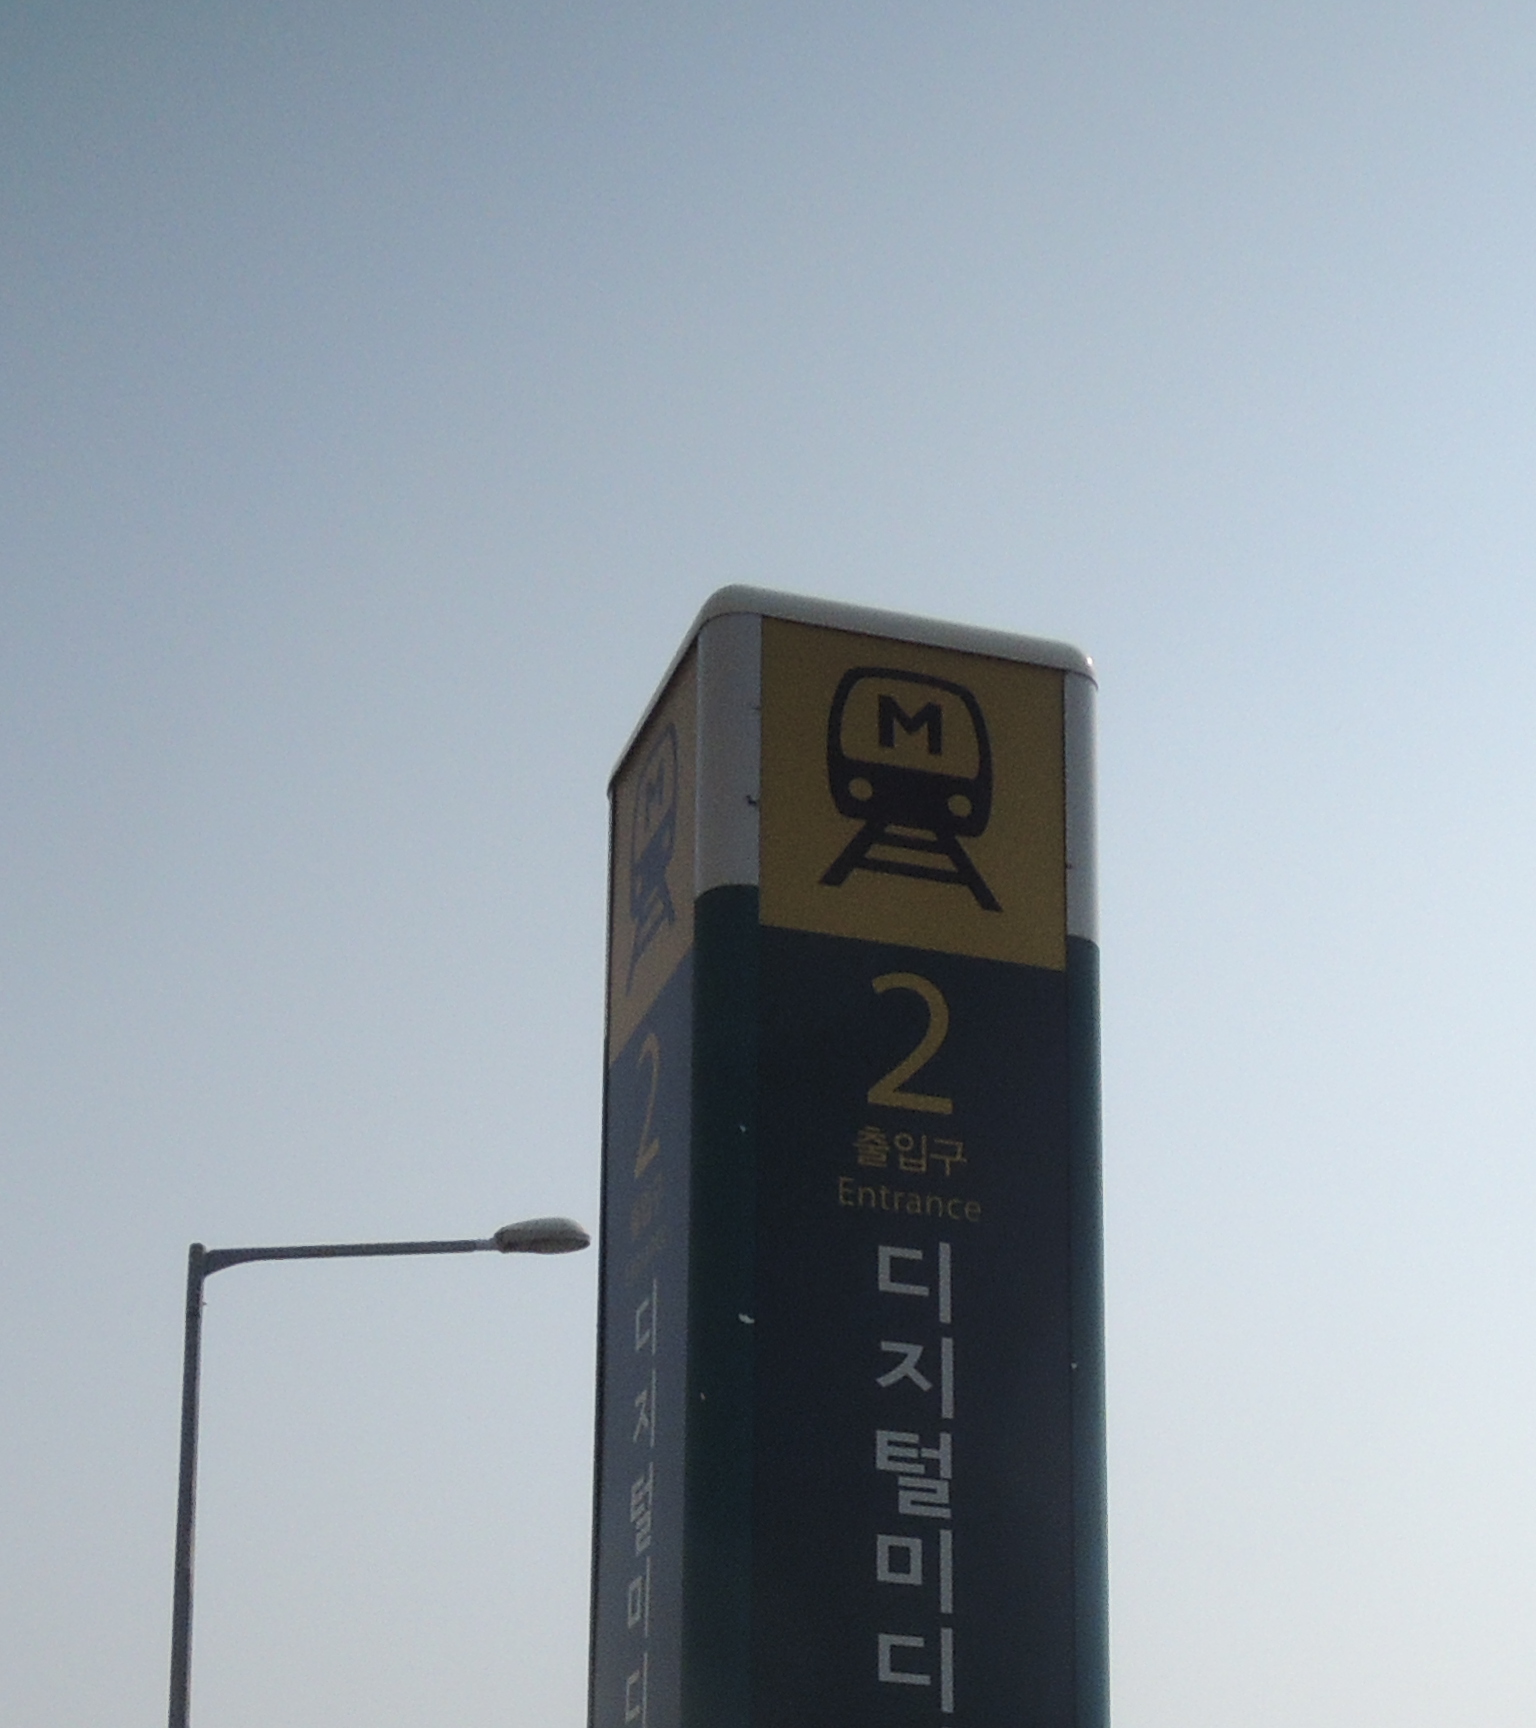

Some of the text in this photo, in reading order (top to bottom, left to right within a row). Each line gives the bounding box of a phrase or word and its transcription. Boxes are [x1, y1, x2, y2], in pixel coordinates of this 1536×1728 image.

[878, 695, 942, 756] M
[867, 971, 953, 1115] 2
[634, 1032, 661, 1179] 2
[852, 1125, 967, 1174] 출입구
[837, 1176, 982, 1222] Entrance
